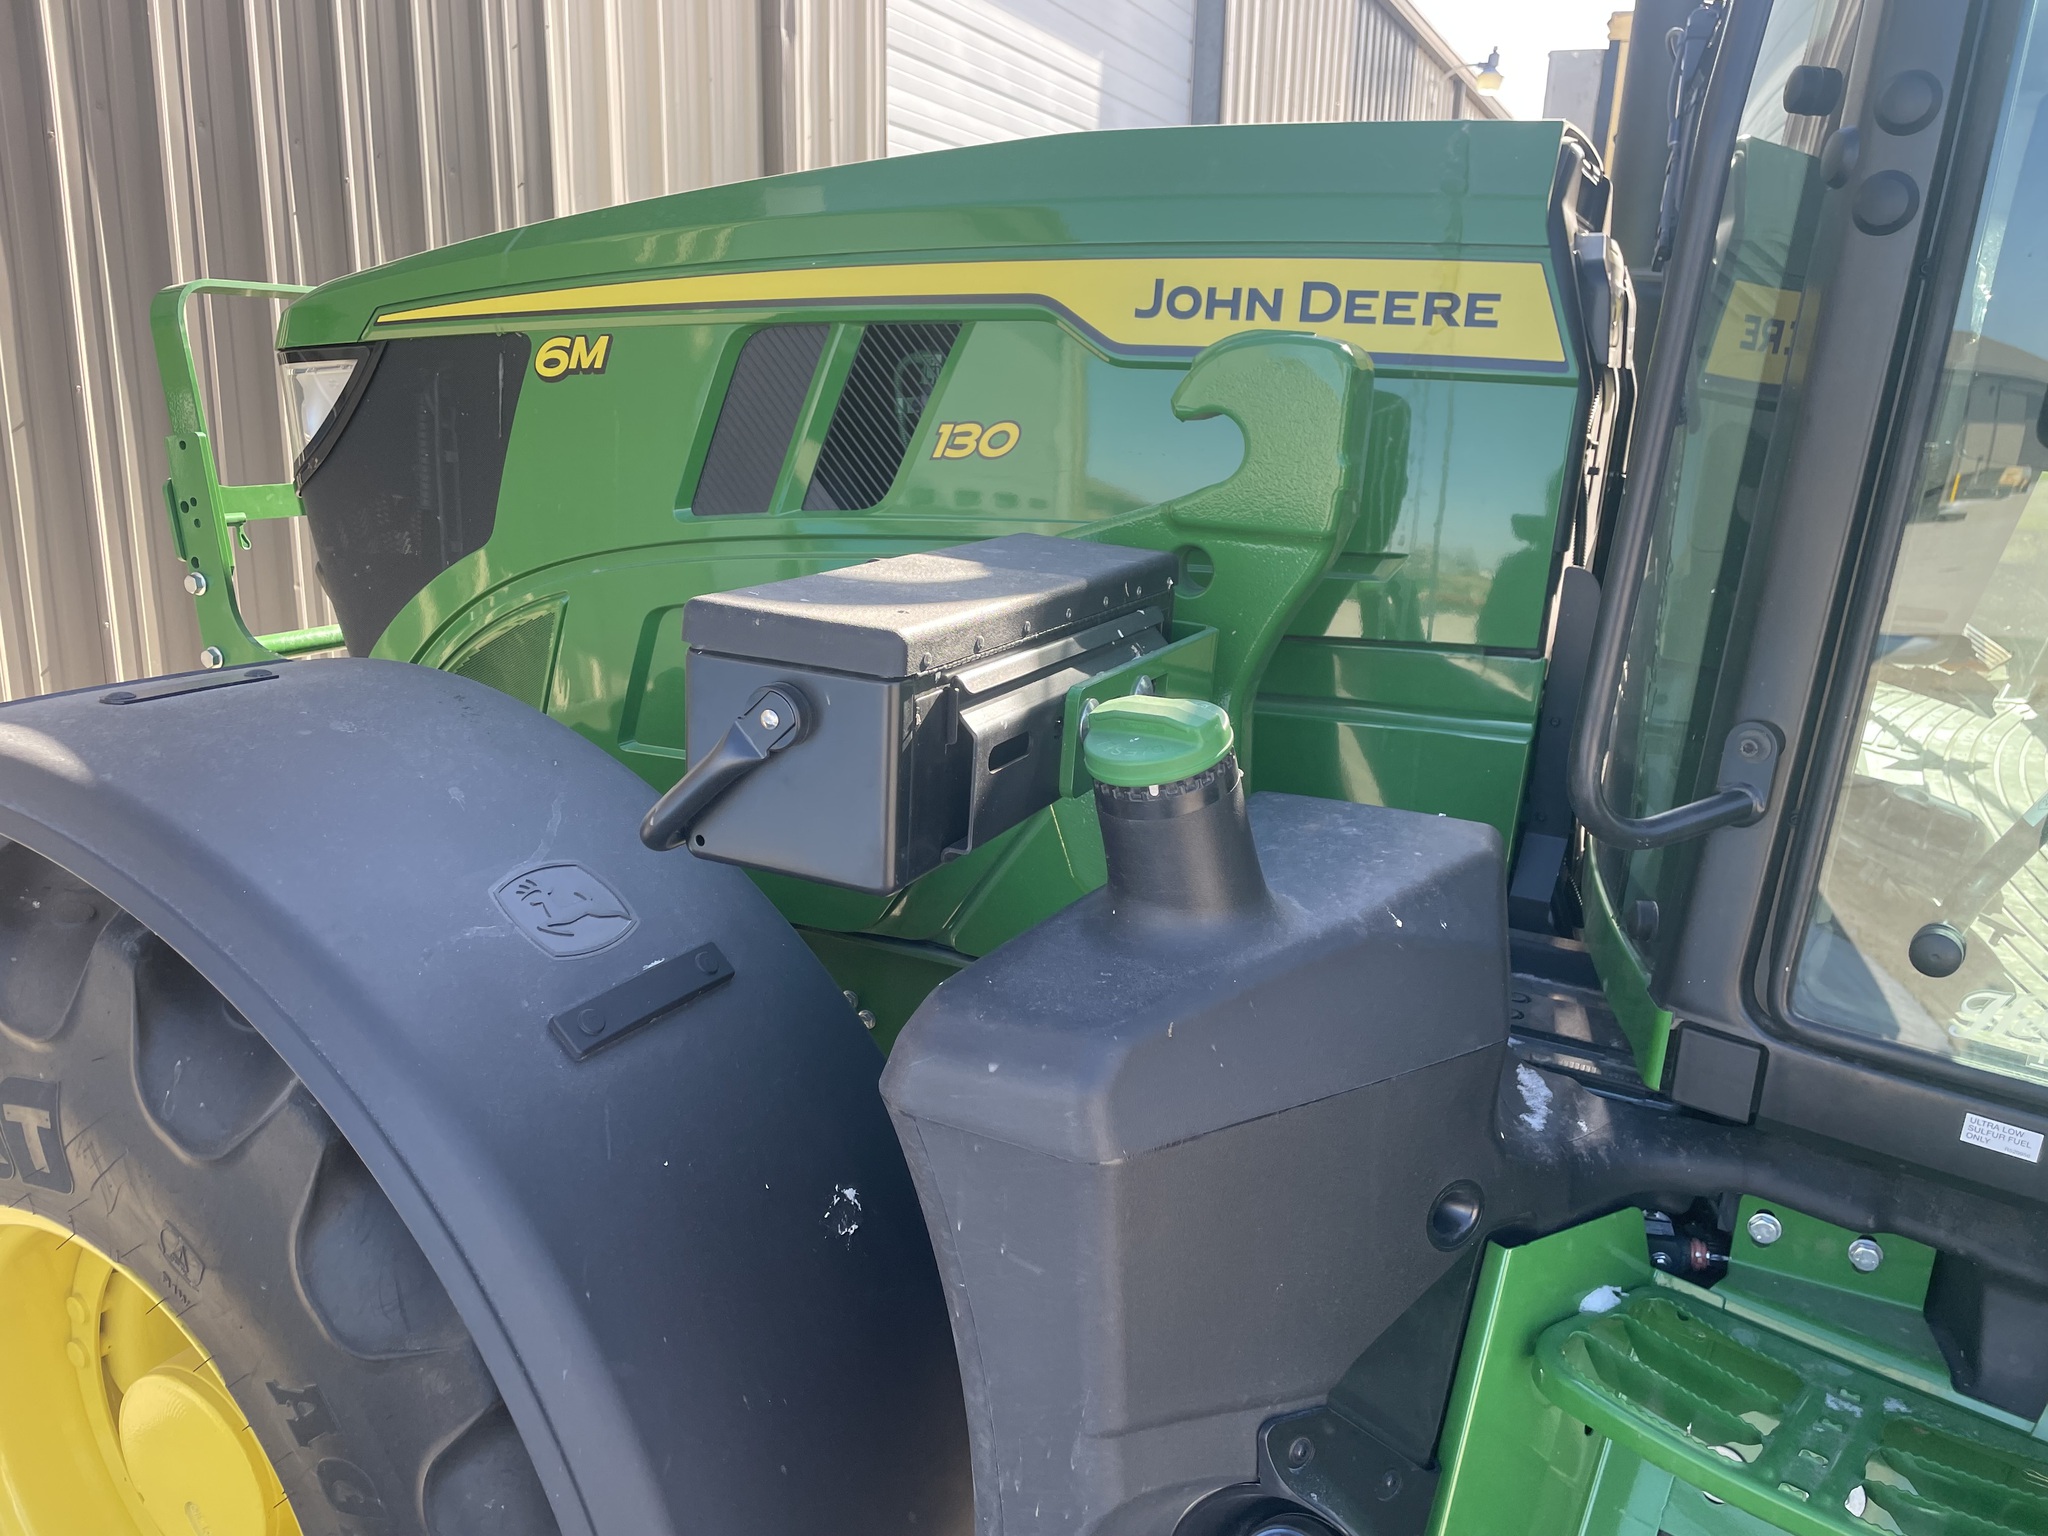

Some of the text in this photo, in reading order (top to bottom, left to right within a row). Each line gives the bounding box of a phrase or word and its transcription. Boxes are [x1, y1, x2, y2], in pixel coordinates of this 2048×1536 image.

[533, 333, 614, 384] 6M
[930, 420, 1022, 461] 130
[1966, 1132, 1991, 1145] ONLY
[1967, 1124, 2032, 1149] SULFUR FUEL
[1969, 1116, 2025, 1138] ULTRA LOW
